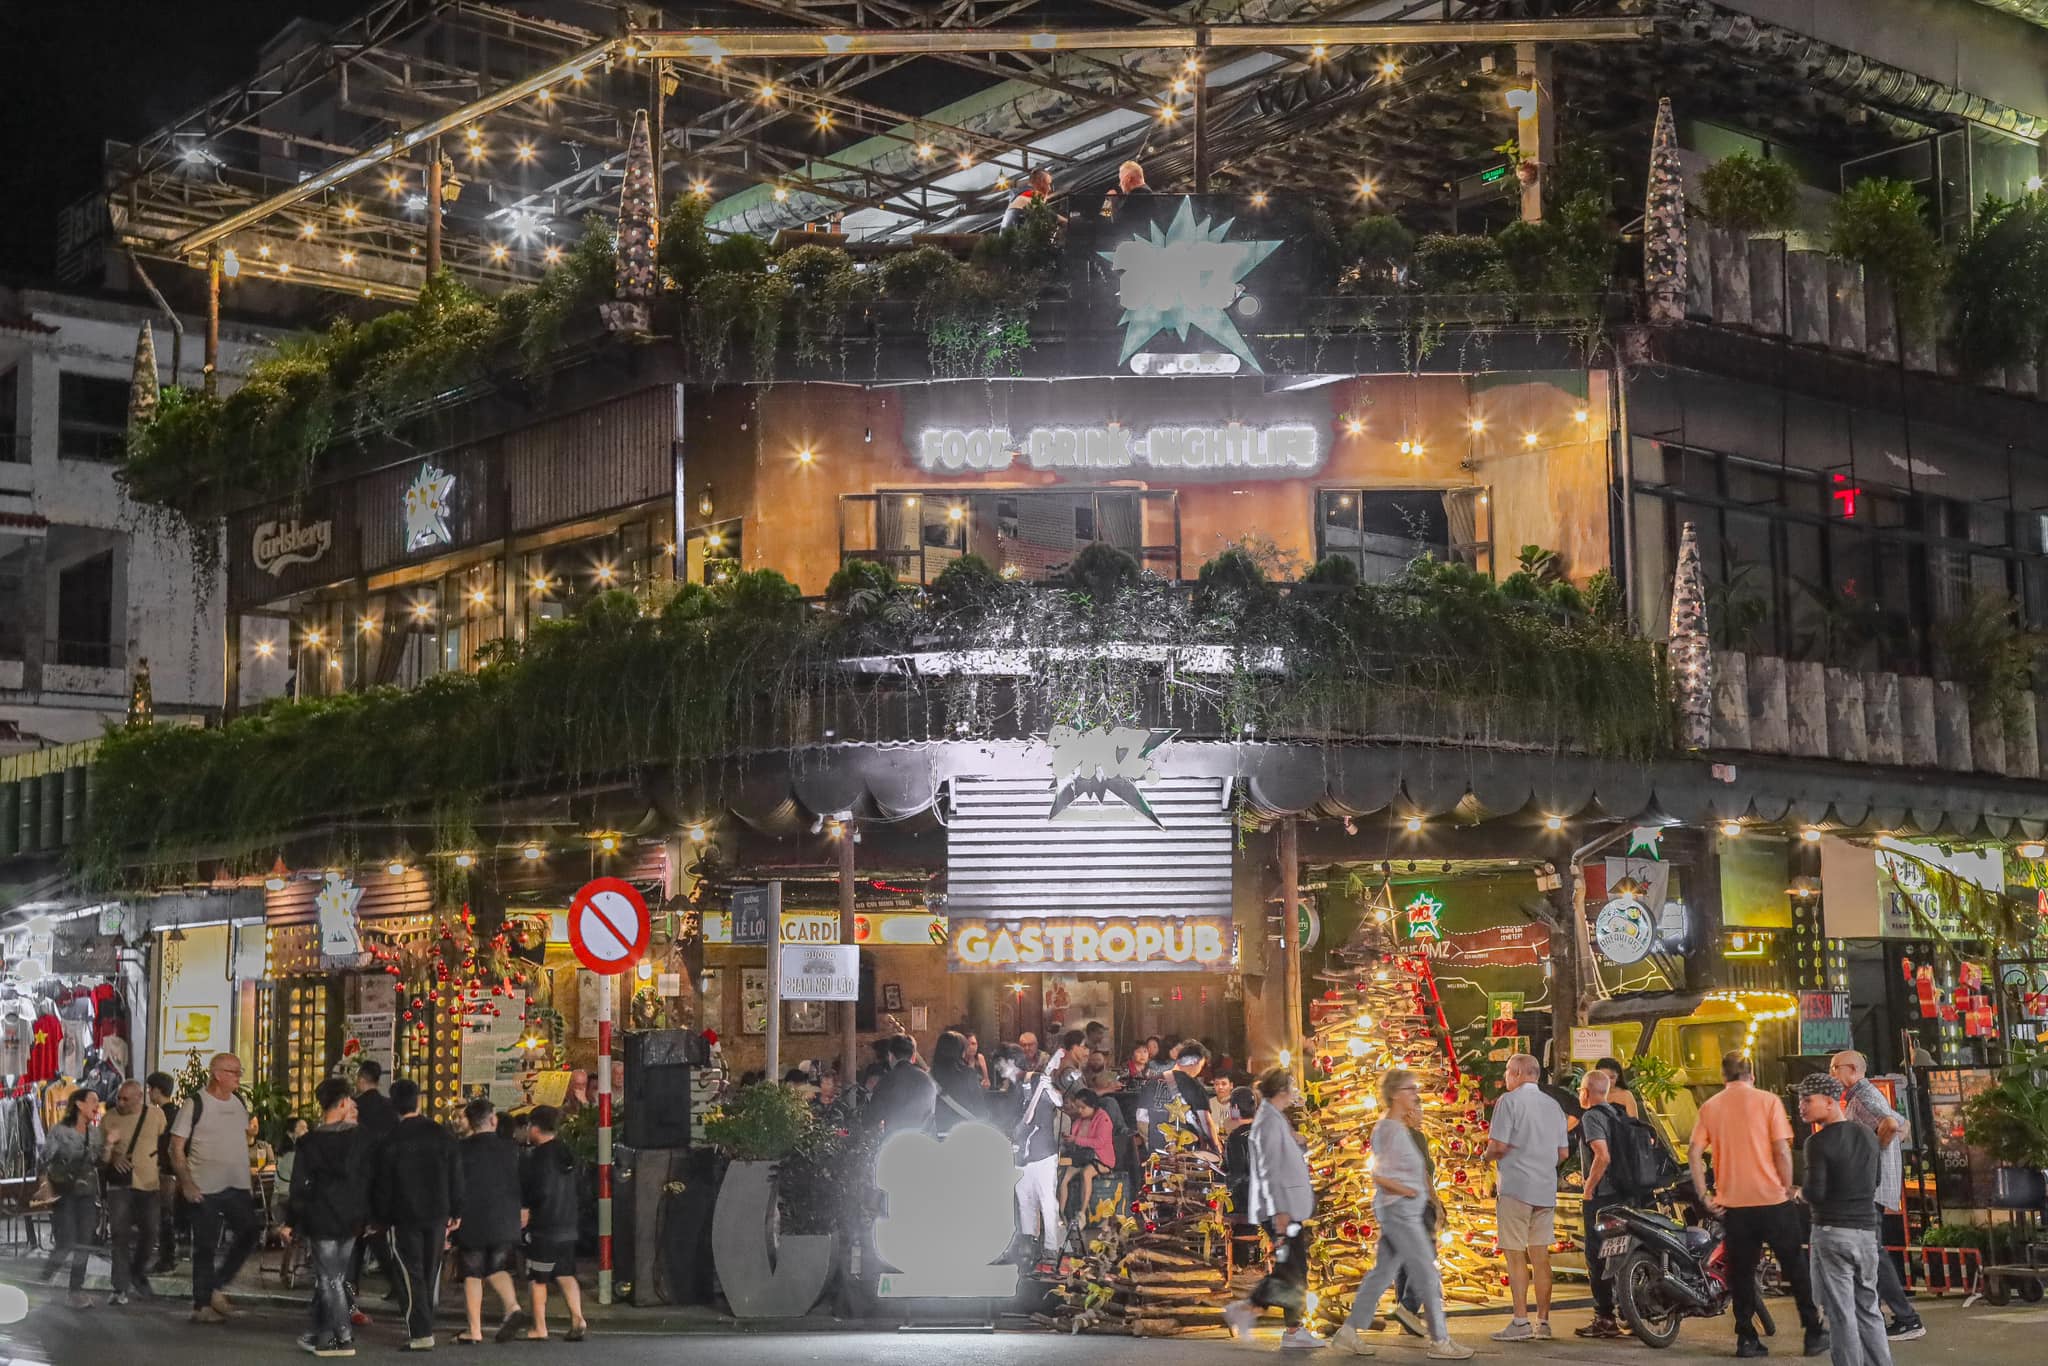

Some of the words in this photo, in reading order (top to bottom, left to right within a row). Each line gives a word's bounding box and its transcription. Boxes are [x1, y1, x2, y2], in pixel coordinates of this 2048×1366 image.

[1030, 429, 1132, 466] DRINK
[1149, 428, 1317, 467] NIGHTLIFE
[252, 519, 333, 577] Carlsberg
[957, 925, 1223, 963] GASTROPUB
[1421, 940, 1451, 959] DMZ
[1832, 993, 1849, 1019] WE
[1928, 1070, 1958, 1081] LIVE
[1937, 1148, 1961, 1160] free
[1944, 1154, 1969, 1170] pool
